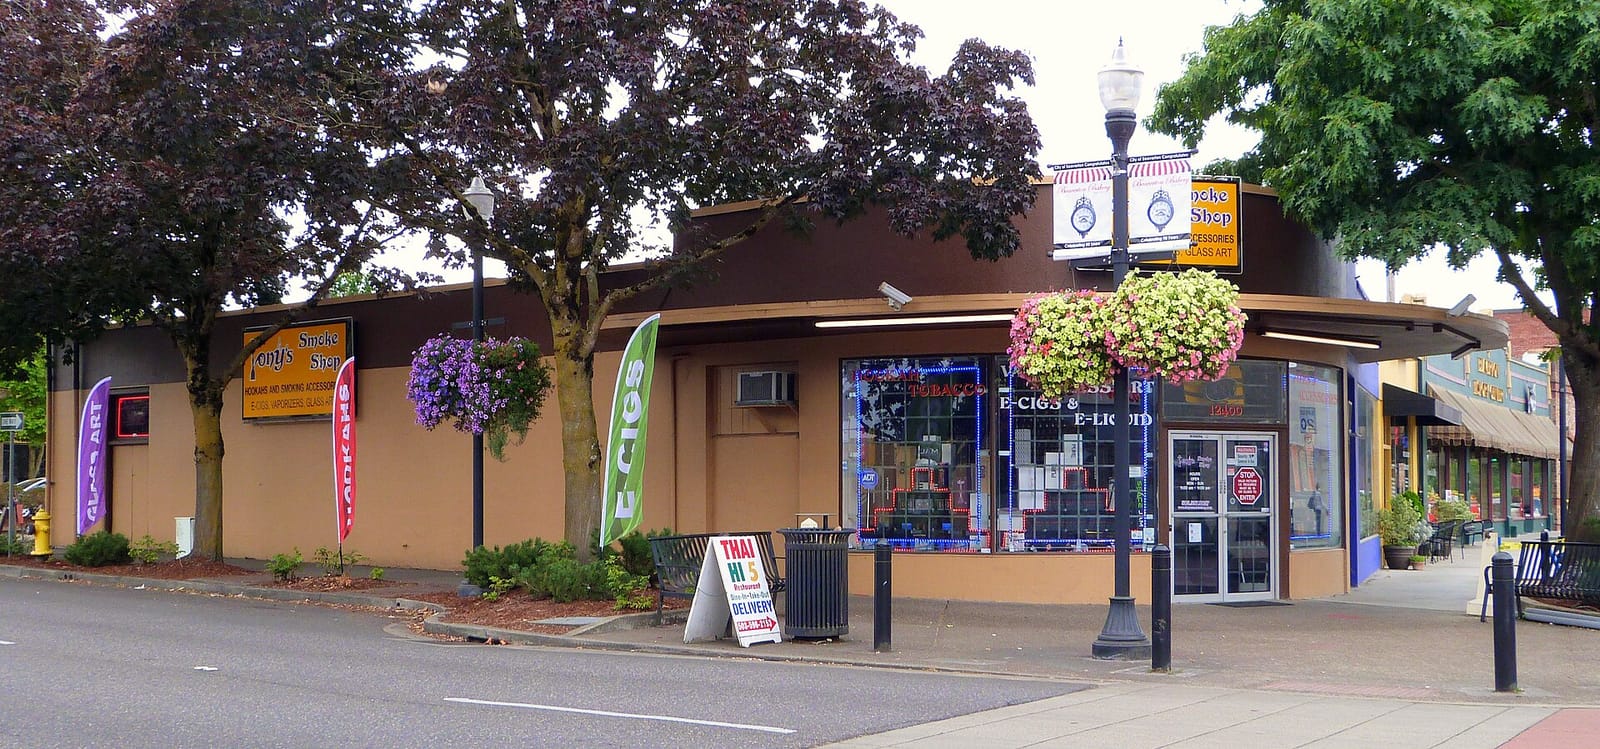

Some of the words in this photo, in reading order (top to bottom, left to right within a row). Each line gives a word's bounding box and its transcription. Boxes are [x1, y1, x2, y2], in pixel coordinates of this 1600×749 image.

[1191, 207, 1231, 227] Shop
[1191, 233, 1235, 244] CESSORIES
[1185, 247, 1214, 257] GLASS
[1215, 248, 1232, 257] ART
[298, 330, 339, 349] Smoke
[310, 353, 341, 372] Shop
[245, 385, 268, 396] HOOKAHS
[269, 384, 280, 395] AND
[280, 383, 305, 393] SMOKING
[306, 381, 336, 392] ACCESSOR
[908, 383, 986, 398] TOBACCO
[1130, 380, 1155, 394] RT
[1000, 396, 1062, 410] E-CIGS
[1067, 397, 1079, 410] &
[91, 401, 102, 444] ART
[862, 473, 875, 482] ADT
[1240, 471, 1256, 479] STOP
[720, 538, 755, 560] THAI
[727, 561, 746, 583] HI
[747, 561, 759, 582] 5
[733, 582, 761, 591] Restaurant
[732, 600, 773, 616] DELIVERY
